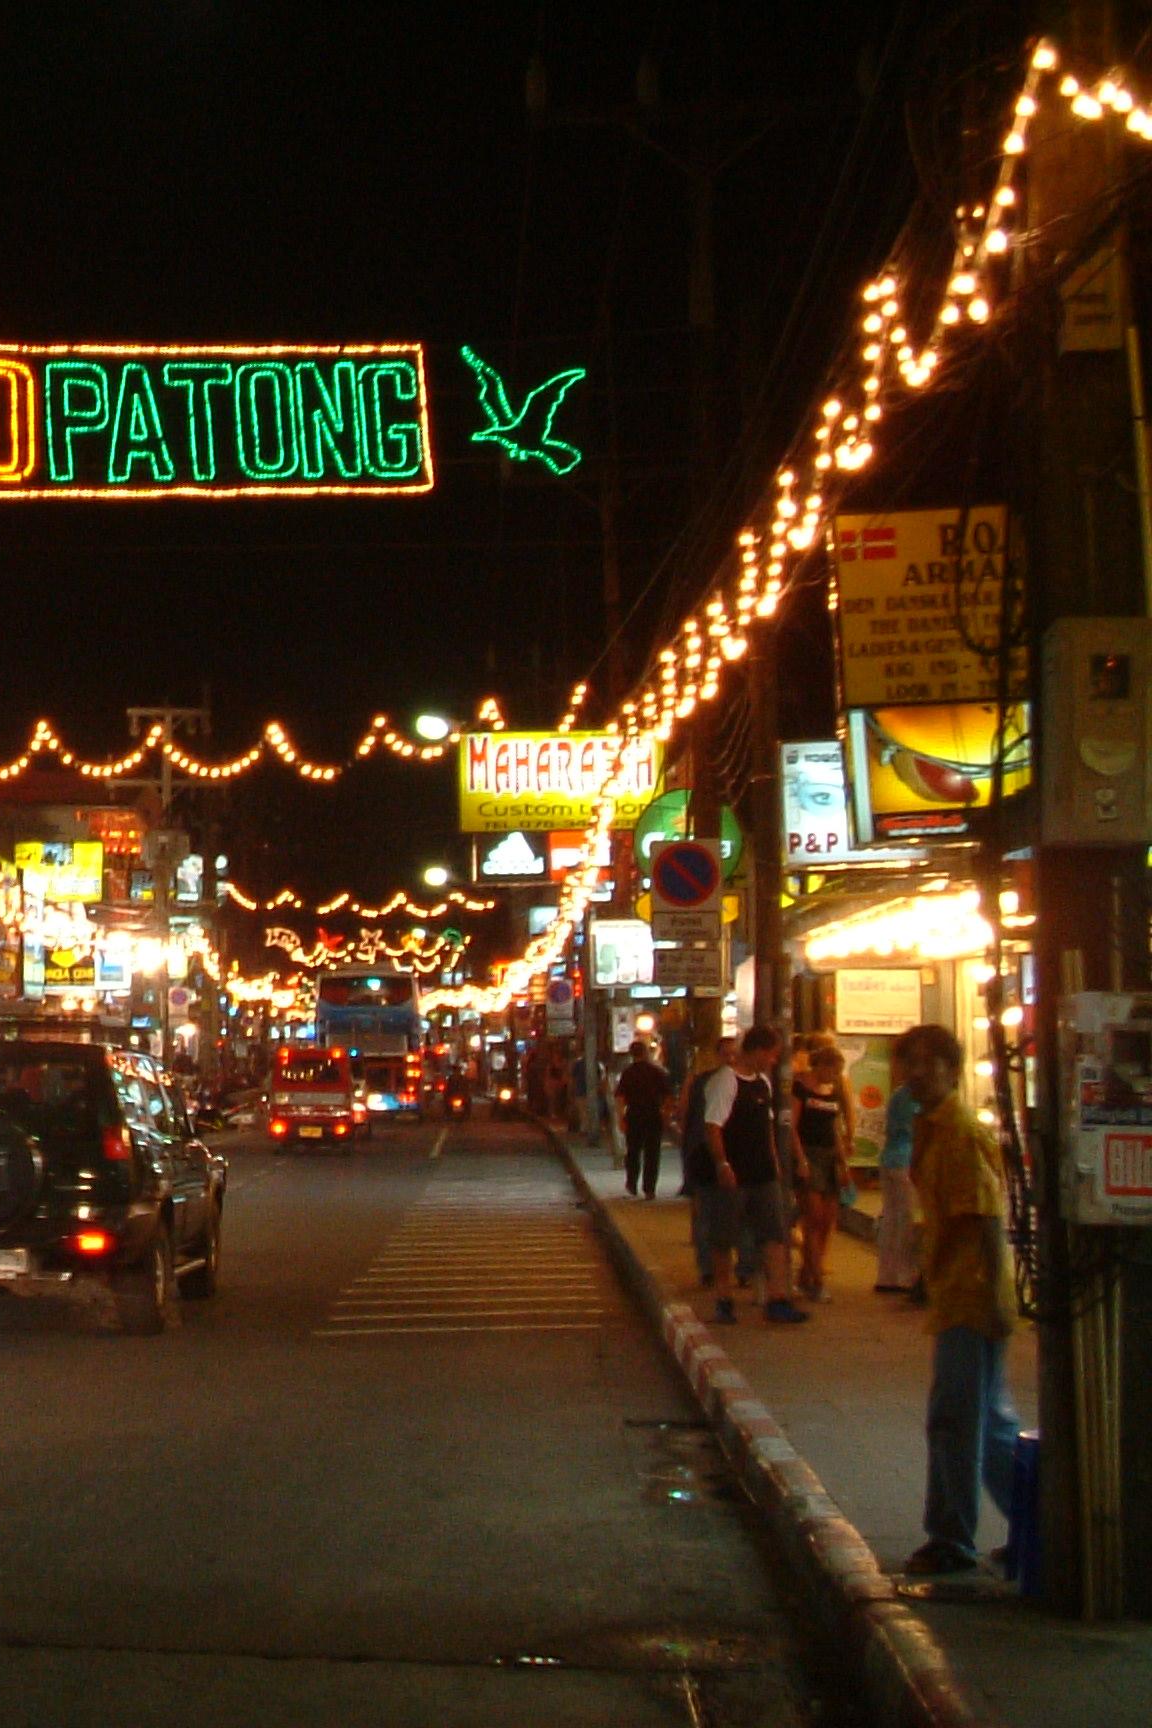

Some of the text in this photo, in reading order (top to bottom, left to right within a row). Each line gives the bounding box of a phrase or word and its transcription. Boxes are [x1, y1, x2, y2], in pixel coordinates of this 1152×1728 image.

[45, 361, 421, 482] PATONG
[479, 799, 648, 818] Custom tlor
